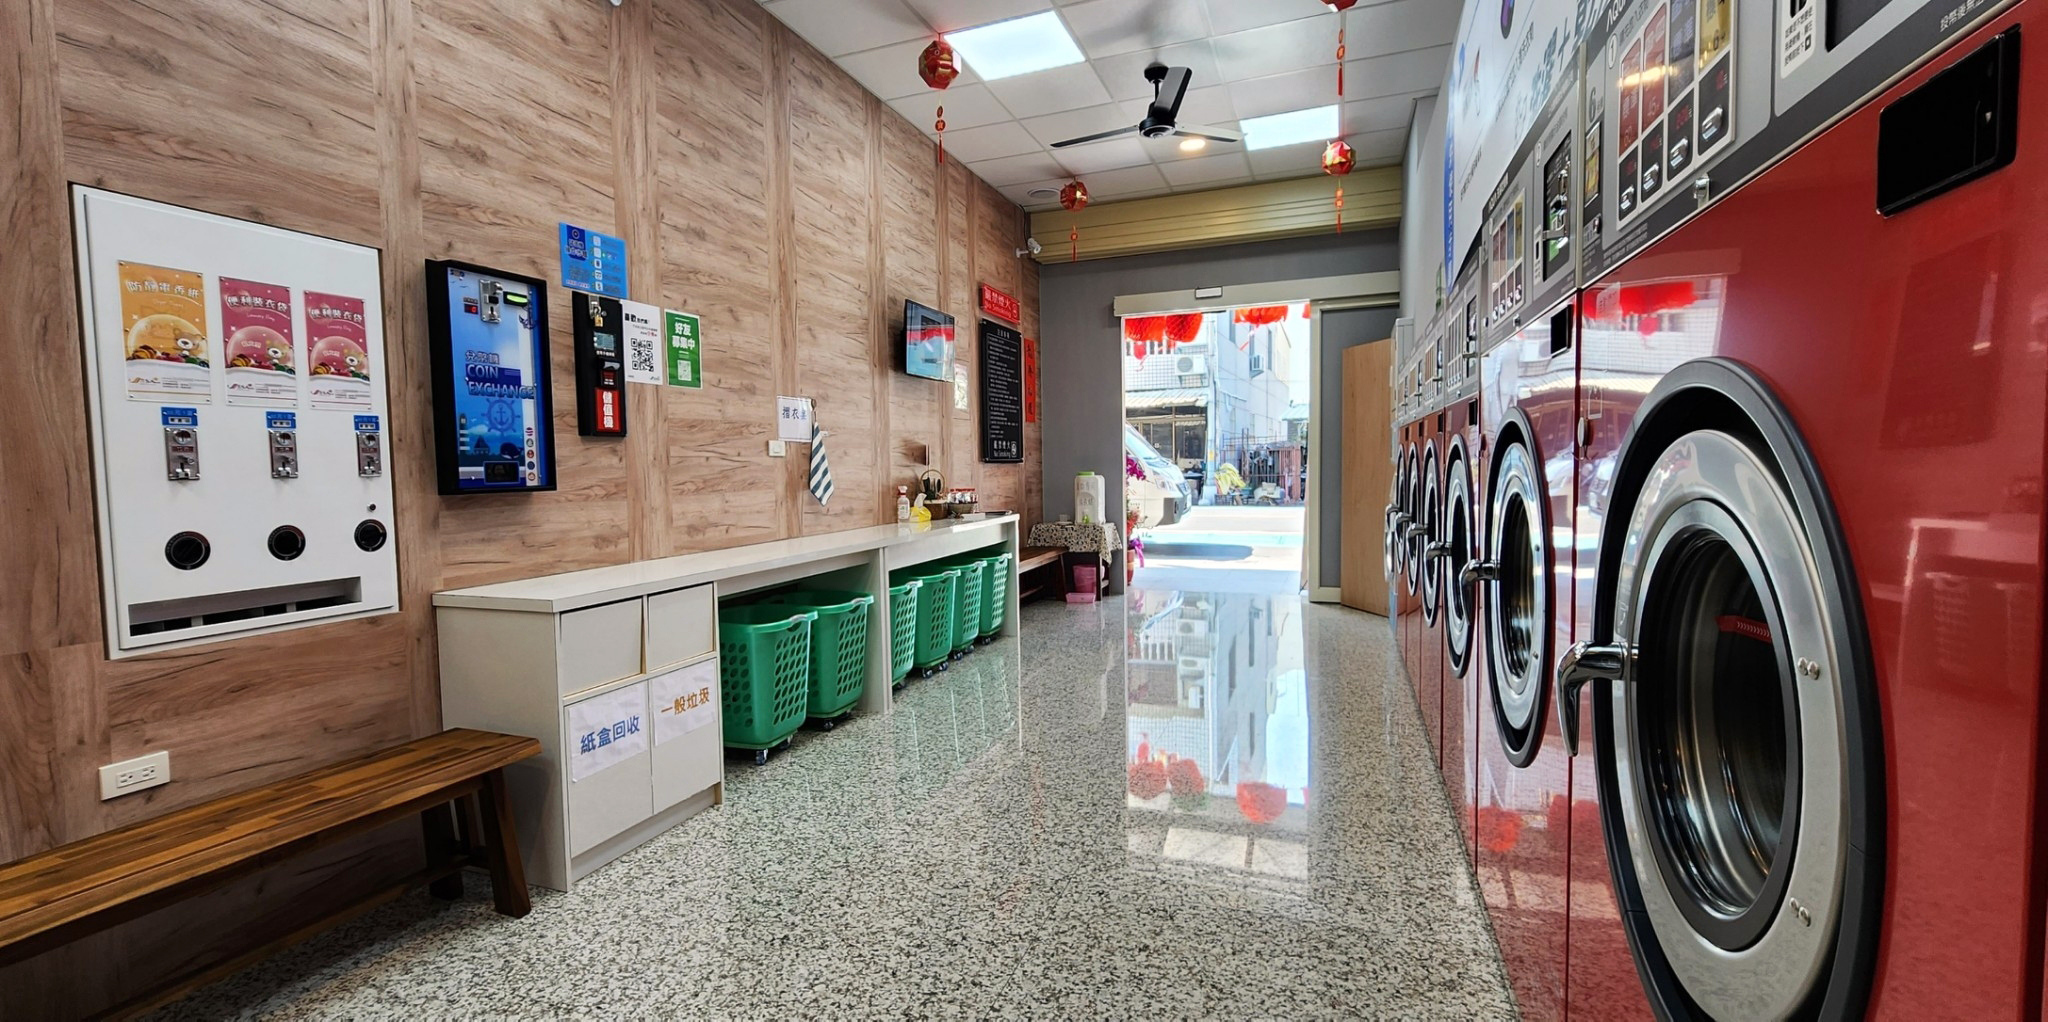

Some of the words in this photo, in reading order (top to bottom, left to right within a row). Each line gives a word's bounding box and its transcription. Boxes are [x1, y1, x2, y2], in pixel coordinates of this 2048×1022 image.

[227, 294, 289, 313] 便利裝衣袋
[674, 321, 691, 336] 好友
[672, 335, 695, 350] 募集中
[467, 364, 499, 379] COIN
[468, 381, 535, 399] EXCHANGE
[661, 687, 710, 715] 一般垃圾
[580, 715, 640, 755] 紙盒回收
